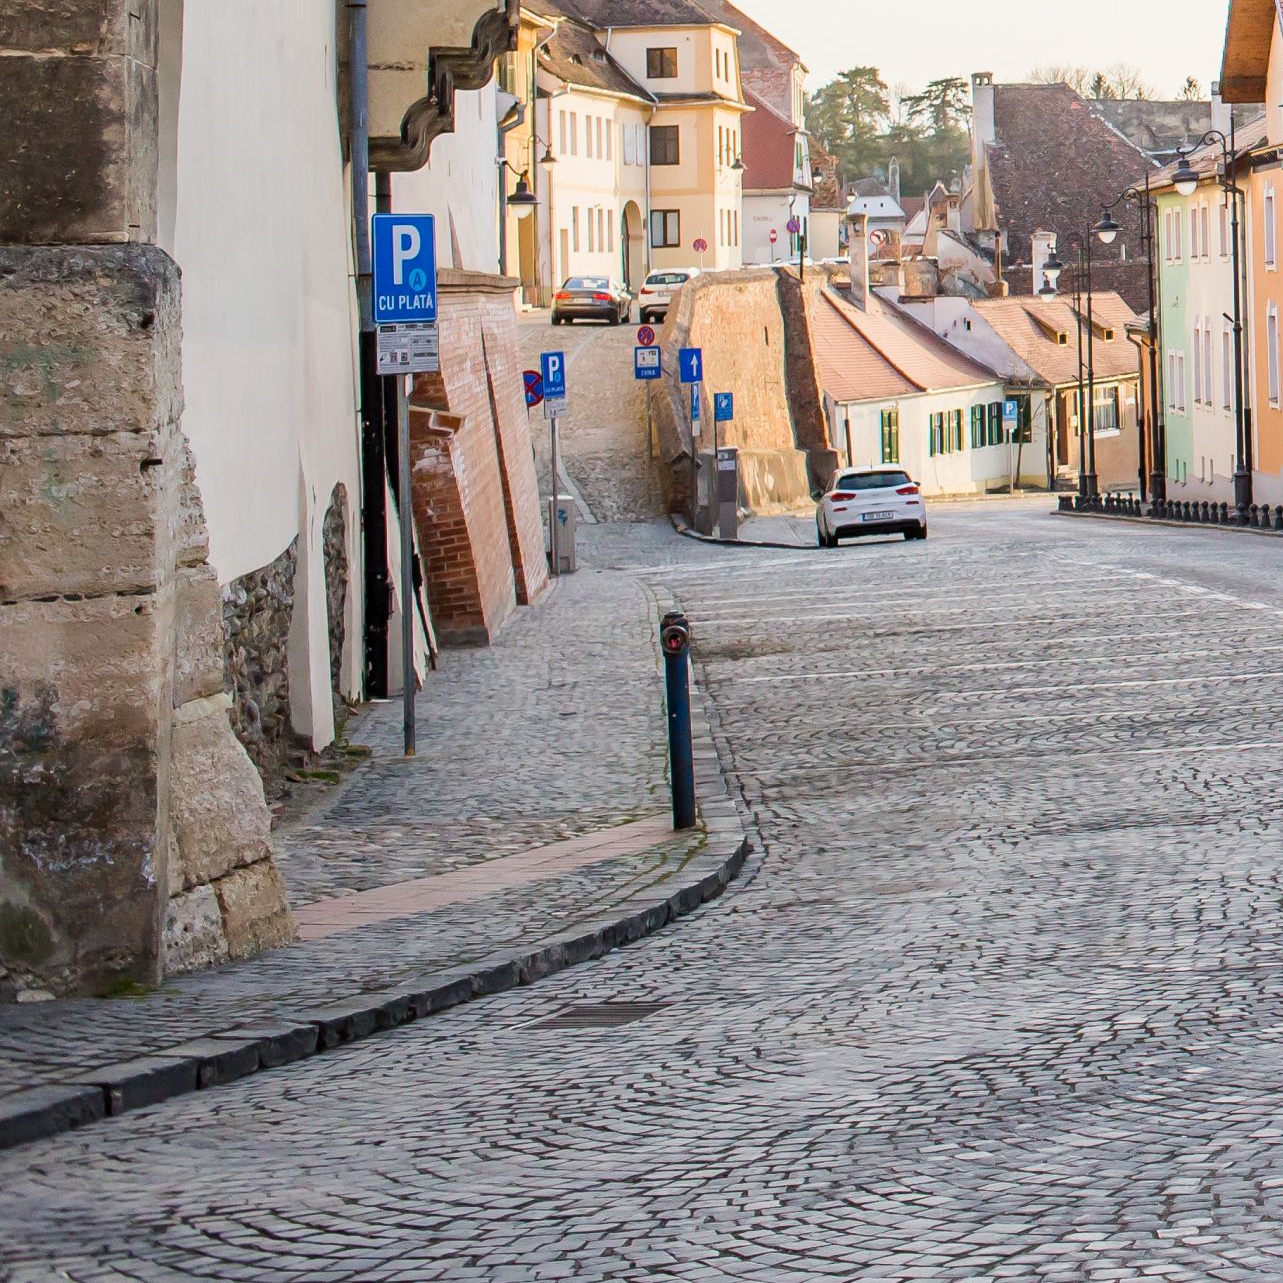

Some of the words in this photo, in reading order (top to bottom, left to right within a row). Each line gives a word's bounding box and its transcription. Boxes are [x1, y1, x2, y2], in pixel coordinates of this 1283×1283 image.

[392, 224, 421, 284] P
[413, 272, 423, 288] A
[379, 295, 394, 310] CU
[399, 292, 433, 310] PLATĂ
[549, 356, 559, 382] P
[1006, 403, 1013, 414] P
